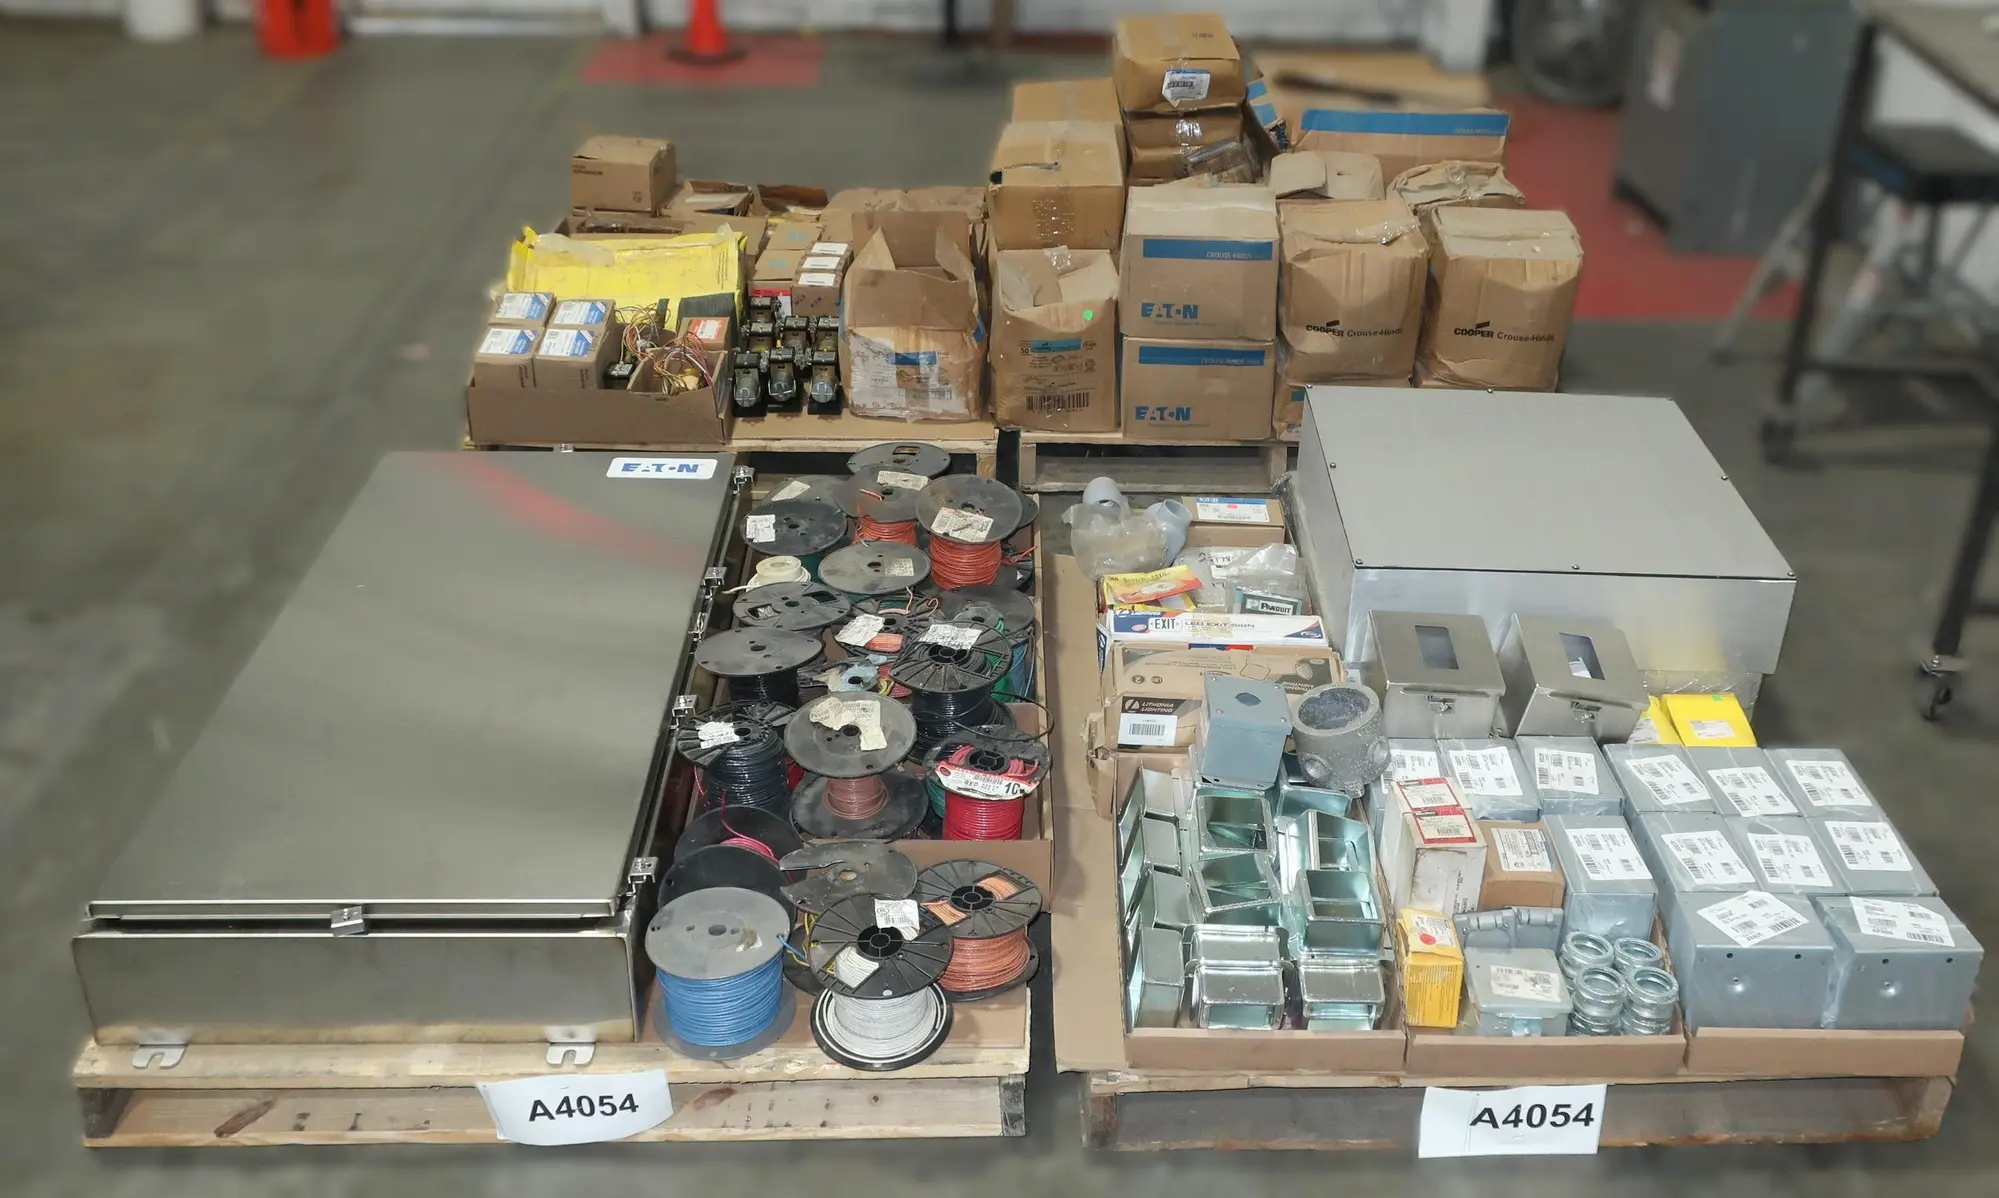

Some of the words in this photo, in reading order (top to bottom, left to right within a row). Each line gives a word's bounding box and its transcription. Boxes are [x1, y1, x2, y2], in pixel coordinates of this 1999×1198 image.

[1141, 302, 1200, 319] EATON
[1305, 324, 1345, 337] COOPER
[1453, 327, 1494, 338] COOPER
[1497, 331, 1555, 342] Crouse-Hinds
[1135, 406, 1191, 421] EATON
[621, 462, 700, 474] EATON
[1260, 602, 1292, 614] PANDUIT
[1155, 618, 1176, 630] EXIT
[528, 1093, 640, 1122] A4054
[1469, 1102, 1595, 1130] A4054
